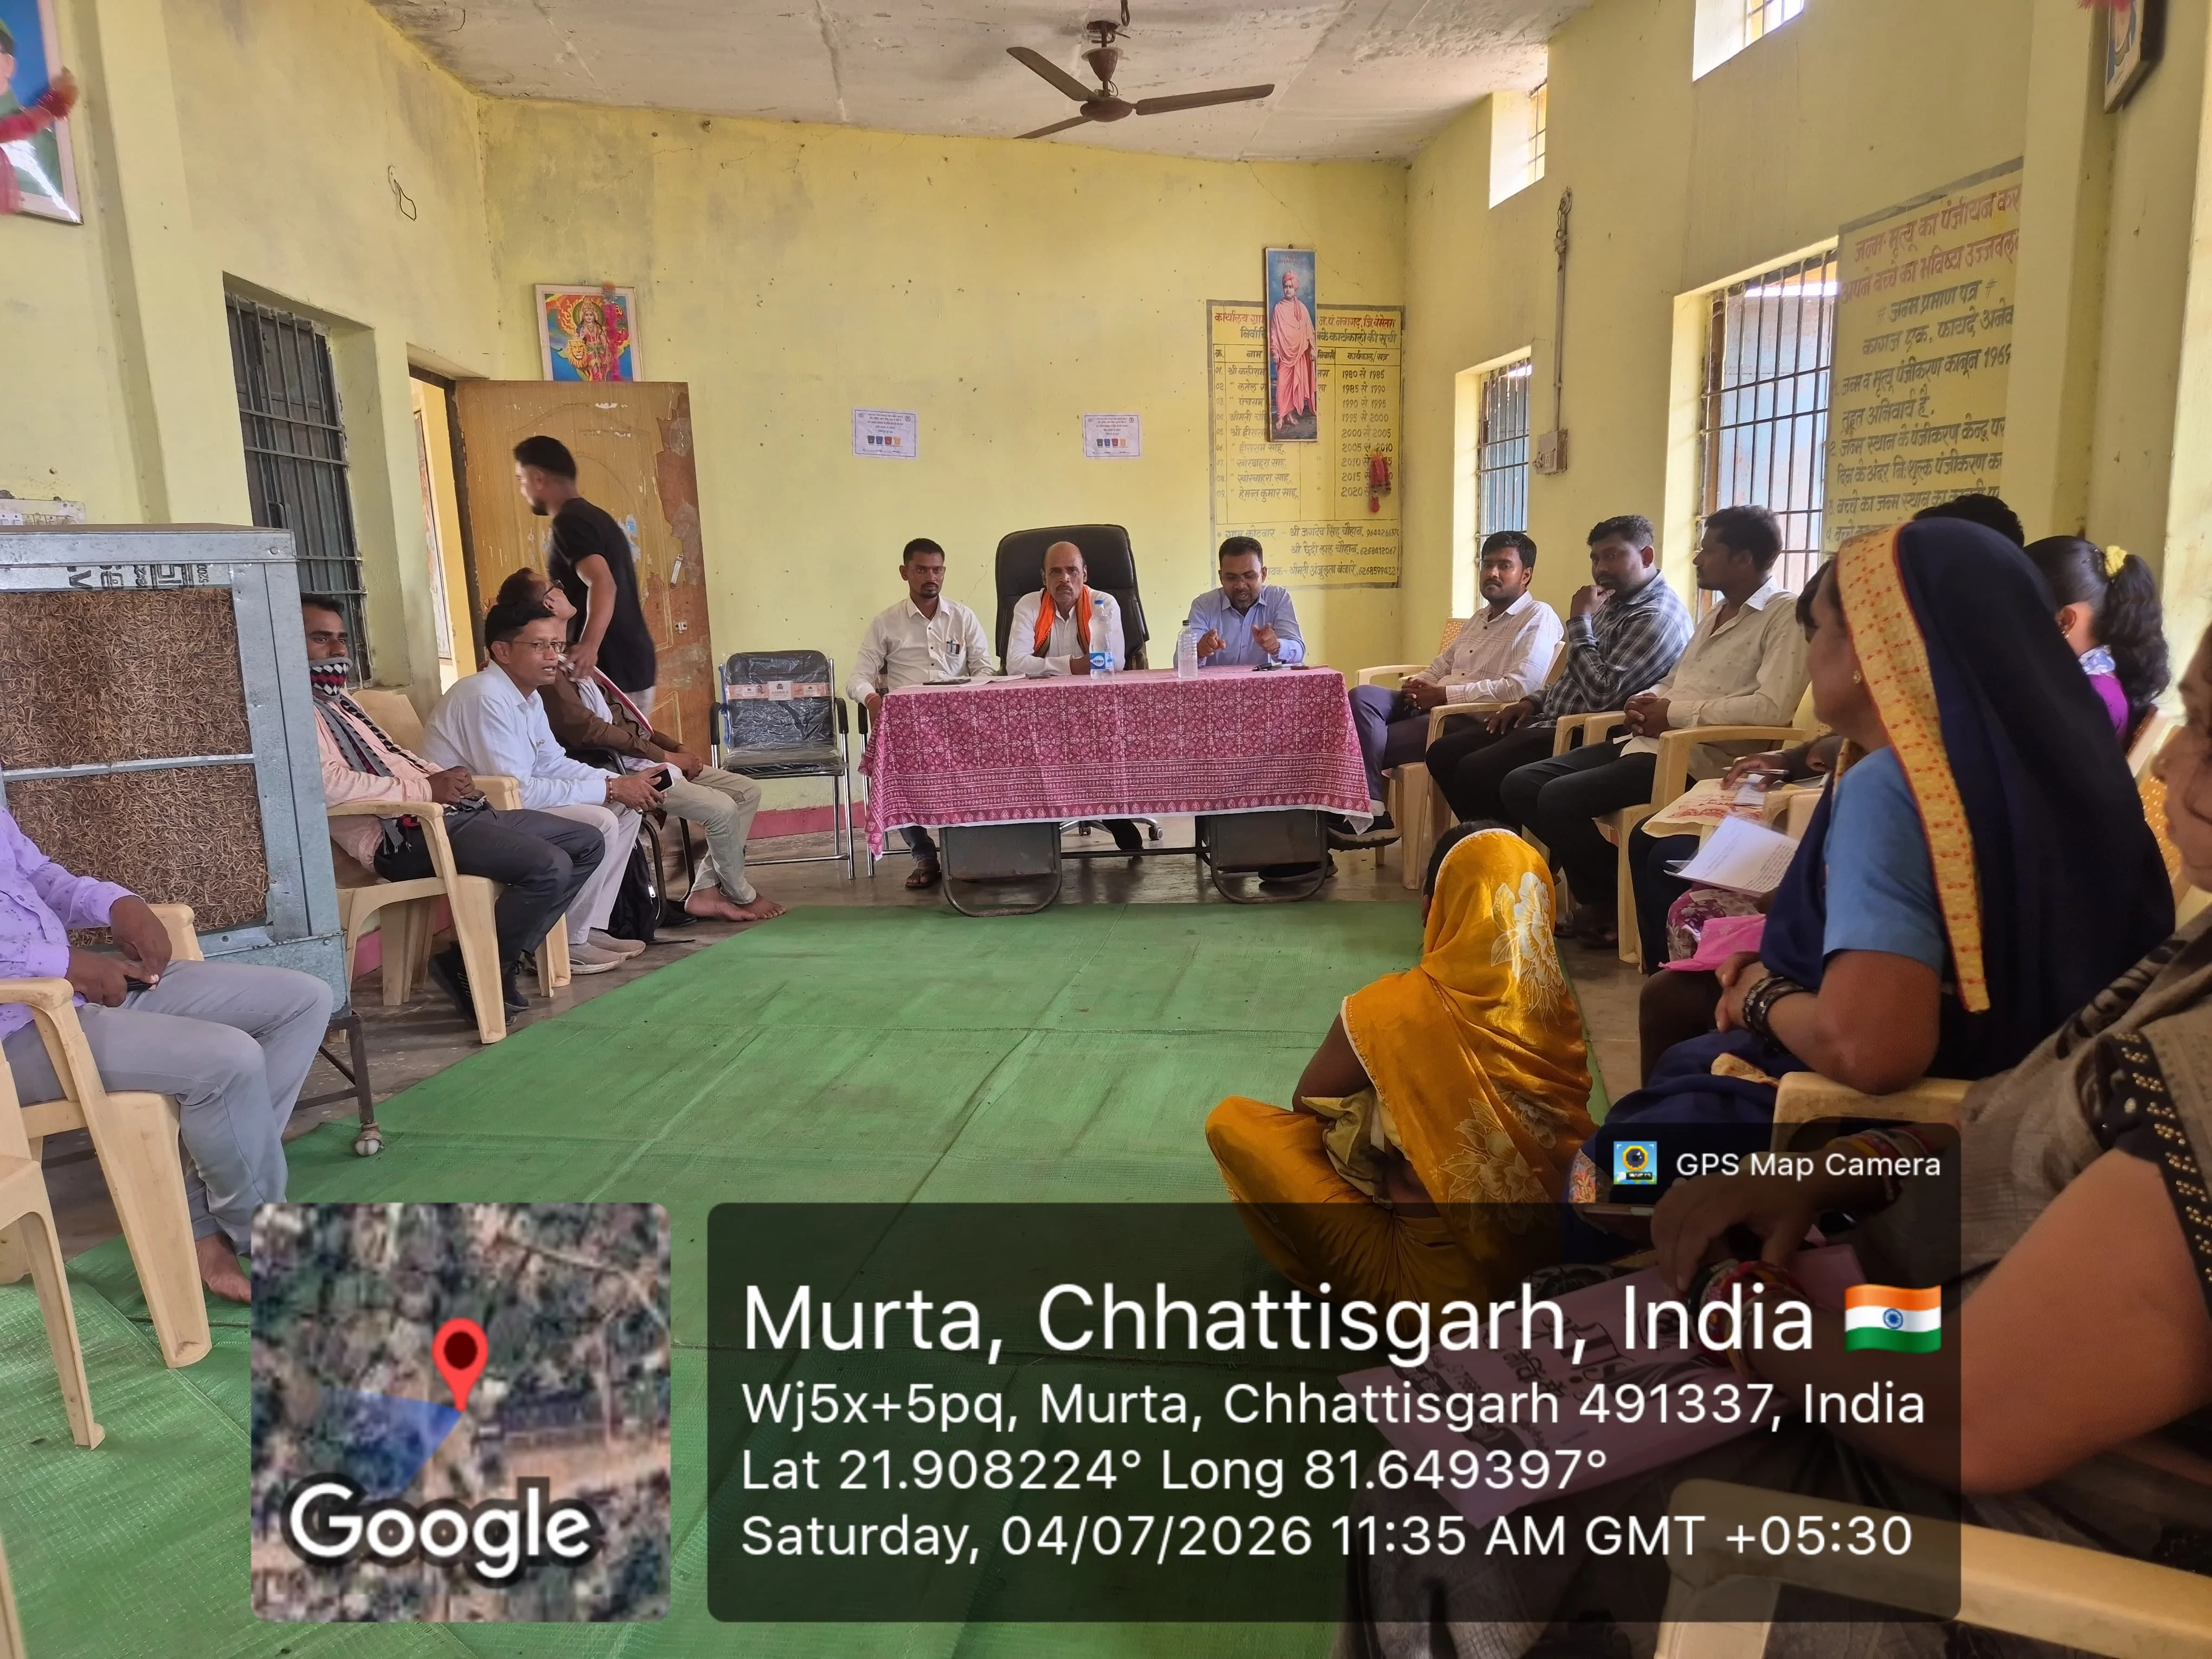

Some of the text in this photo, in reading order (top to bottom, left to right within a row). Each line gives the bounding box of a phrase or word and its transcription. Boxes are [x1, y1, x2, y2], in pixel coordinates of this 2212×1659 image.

[1918, 213, 1940, 237] का
[1998, 183, 2022, 212] कर
[1900, 260, 1919, 282] का
[1889, 295, 1920, 322] जन्म
[1920, 285, 1959, 315] प्रमाण
[1959, 280, 1982, 304] पत्र
[1214, 310, 1249, 325] कार्यालय
[1367, 329, 1378, 343] की
[1379, 330, 1397, 348] सूची
[1246, 350, 1263, 358] नाम
[1227, 364, 1237, 375] श्री
[1342, 369, 1358, 380] 1980
[1360, 367, 1367, 379] से
[1369, 369, 1385, 380] 1985
[1944, 349, 1982, 380] कानून
[1342, 384, 1359, 395] 1985
[1361, 381, 1368, 395] से
[1371, 384, 1386, 394] 1990
[1342, 398, 1358, 408] 1990
[1361, 396, 1368, 408] से
[1371, 398, 1386, 409] 1995
[1360, 410, 1368, 422] से
[1369, 413, 1388, 423] 2000
[1231, 425, 1241, 436] श्री
[1341, 428, 1362, 438] 2000
[1373, 428, 1391, 438] 2005
[1342, 443, 1362, 453] 2005
[1840, 436, 1866, 457] जन्म
[1868, 432, 1898, 455] स्थान
[1341, 457, 1361, 467] 2010
[1341, 472, 1361, 482] 2015
[1837, 462, 1855, 487] दिन
[1854, 457, 1867, 483] के
[1261, 488, 1281, 503] कुमार
[1341, 487, 1363, 498] 2020
[1860, 496, 1876, 512] का
[1876, 493, 1901, 511] जन्म
[1246, 525, 1276, 541] कोटवार
[1290, 525, 1301, 537] श्री
[1301, 524, 1326, 538] जगदेव
[1327, 524, 1342, 539] सिंह
[1291, 543, 1302, 554] श्री
[1320, 544, 1334, 556] लाल
[1289, 561, 1309, 578] श्रीमती
